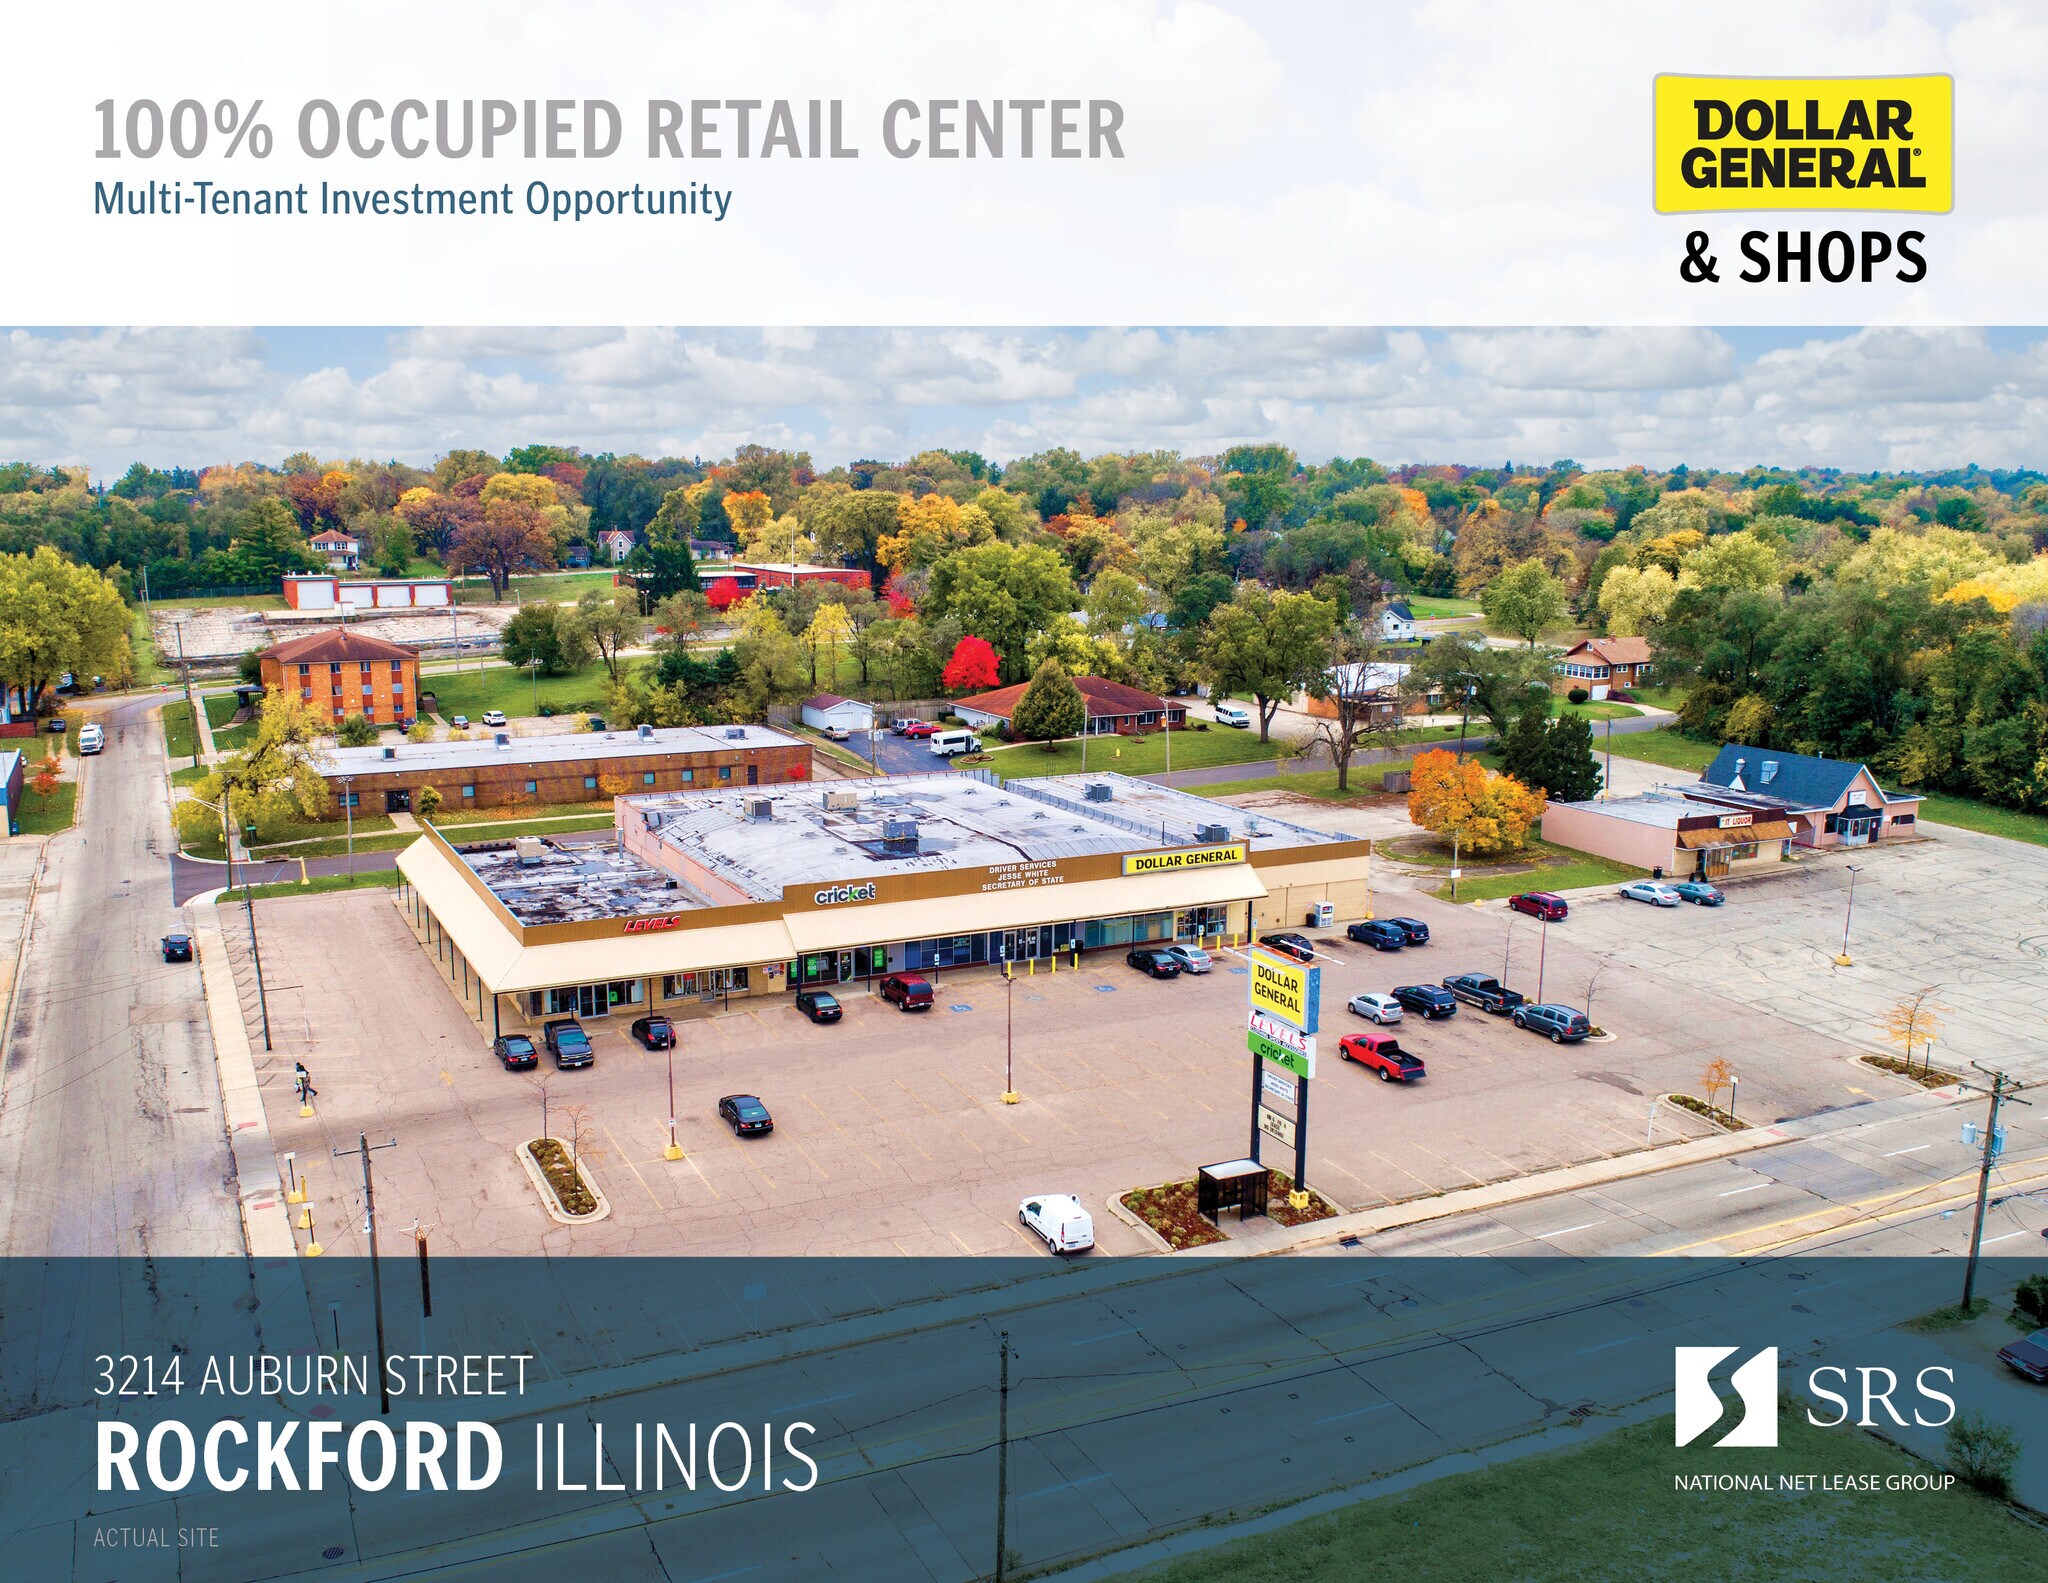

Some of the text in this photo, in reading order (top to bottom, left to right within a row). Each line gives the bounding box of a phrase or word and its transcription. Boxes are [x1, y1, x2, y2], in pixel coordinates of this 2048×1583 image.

[989, 860, 1057, 874] DRIVER SERVICES
[1135, 850, 1238, 870] DOLLAR GENERAL
[982, 880, 1026, 891] SECRETARY
[1041, 876, 1064, 885] STATE
[998, 869, 1049, 881] JESSE WHITE
[814, 882, 876, 905] cricket
[624, 915, 681, 933] LEVELS
[1257, 965, 1298, 993] DOLLAR
[1254, 982, 1301, 1013] GENERAL
[1250, 1015, 1307, 1051] LEVELS
[1260, 1043, 1295, 1068] cricket
